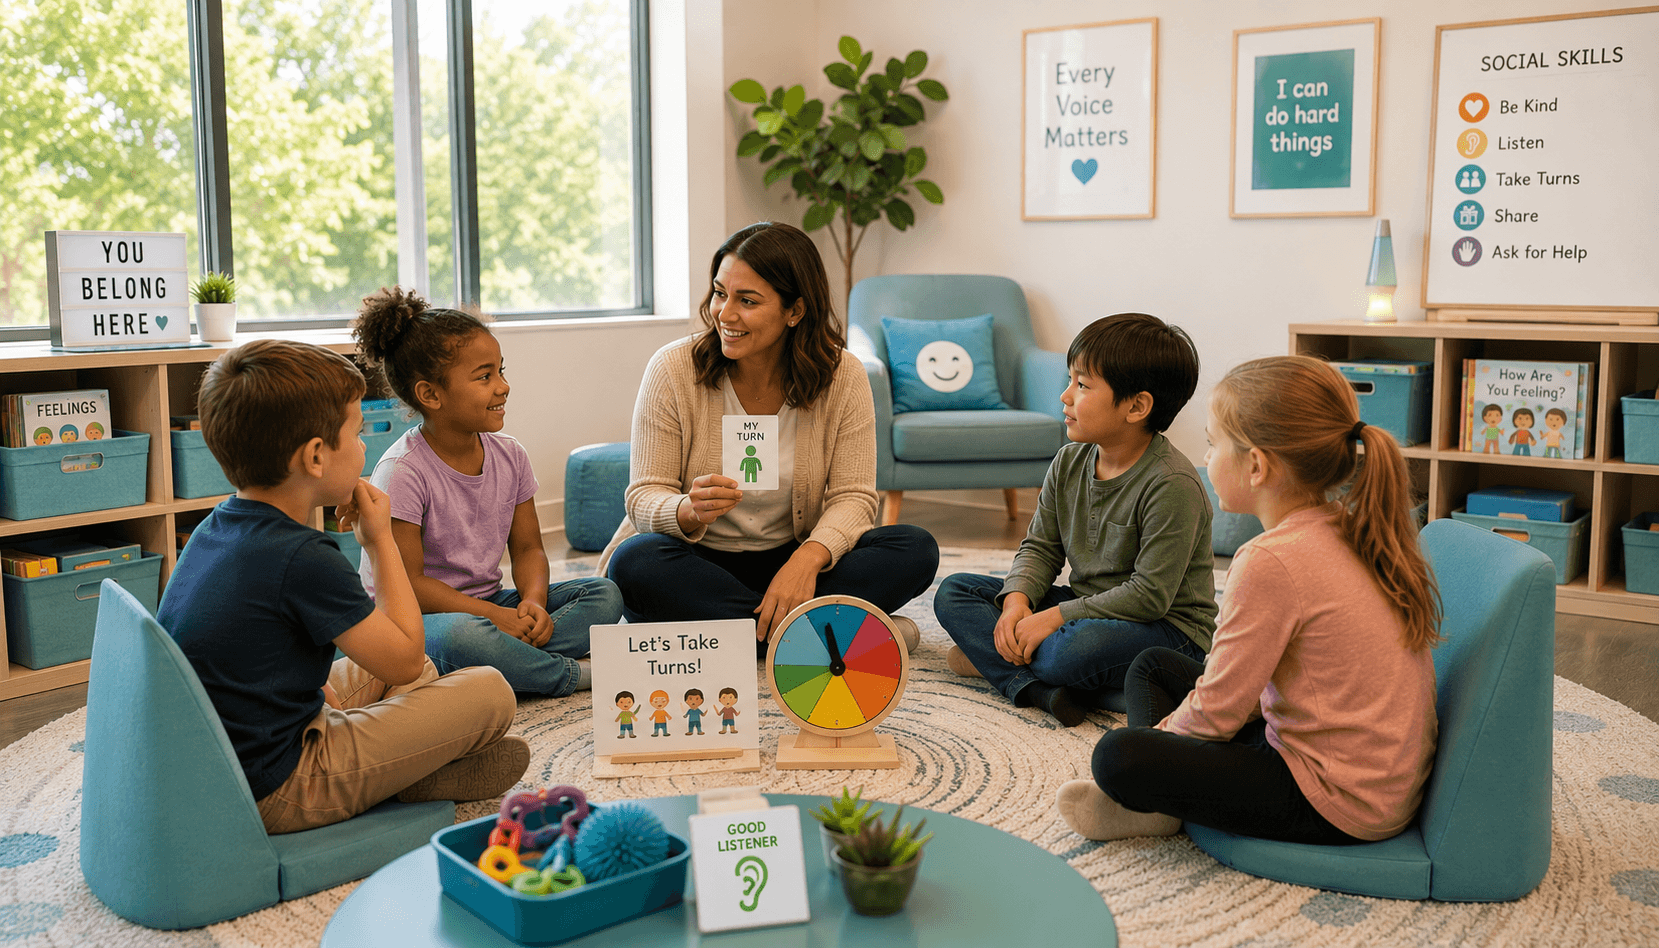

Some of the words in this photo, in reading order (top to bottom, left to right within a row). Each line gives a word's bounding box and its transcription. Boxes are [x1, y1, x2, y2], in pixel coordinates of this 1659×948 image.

[1481, 52, 1550, 72] SOCIAL
[1557, 46, 1624, 67] SKILLS
[1056, 62, 1116, 89] Every
[1276, 78, 1288, 100] I
[1292, 81, 1329, 99] can
[1055, 94, 1114, 117] Voice
[1265, 105, 1290, 126] do
[1294, 102, 1340, 125] hard
[1500, 99, 1519, 115] Be
[1524, 97, 1558, 113] Kind
[1044, 126, 1129, 149] Matters
[1269, 130, 1333, 158] things
[1498, 136, 1544, 151] Listen
[1496, 172, 1531, 187] Take
[1536, 171, 1580, 186] Turns
[1494, 208, 1539, 223] Share
[101, 240, 144, 264] YOU
[1491, 244, 1519, 259] Ask
[1524, 244, 1548, 259] for
[1552, 244, 1588, 264] Help
[81, 276, 166, 300] BELONG
[93, 312, 149, 336] HERE
[1499, 368, 1527, 381] How
[1530, 369, 1553, 382] Are
[1486, 383, 1509, 396] You
[1513, 384, 1566, 403] Feeling?
[37, 400, 97, 418] FEELINGS
[743, 421, 759, 431] MY
[736, 432, 765, 441] TURN
[628, 635, 671, 653] Let's
[676, 633, 719, 651] Take
[646, 657, 702, 676] Turns!
[727, 821, 767, 836] GOOD
[717, 835, 779, 853] LISTENER
